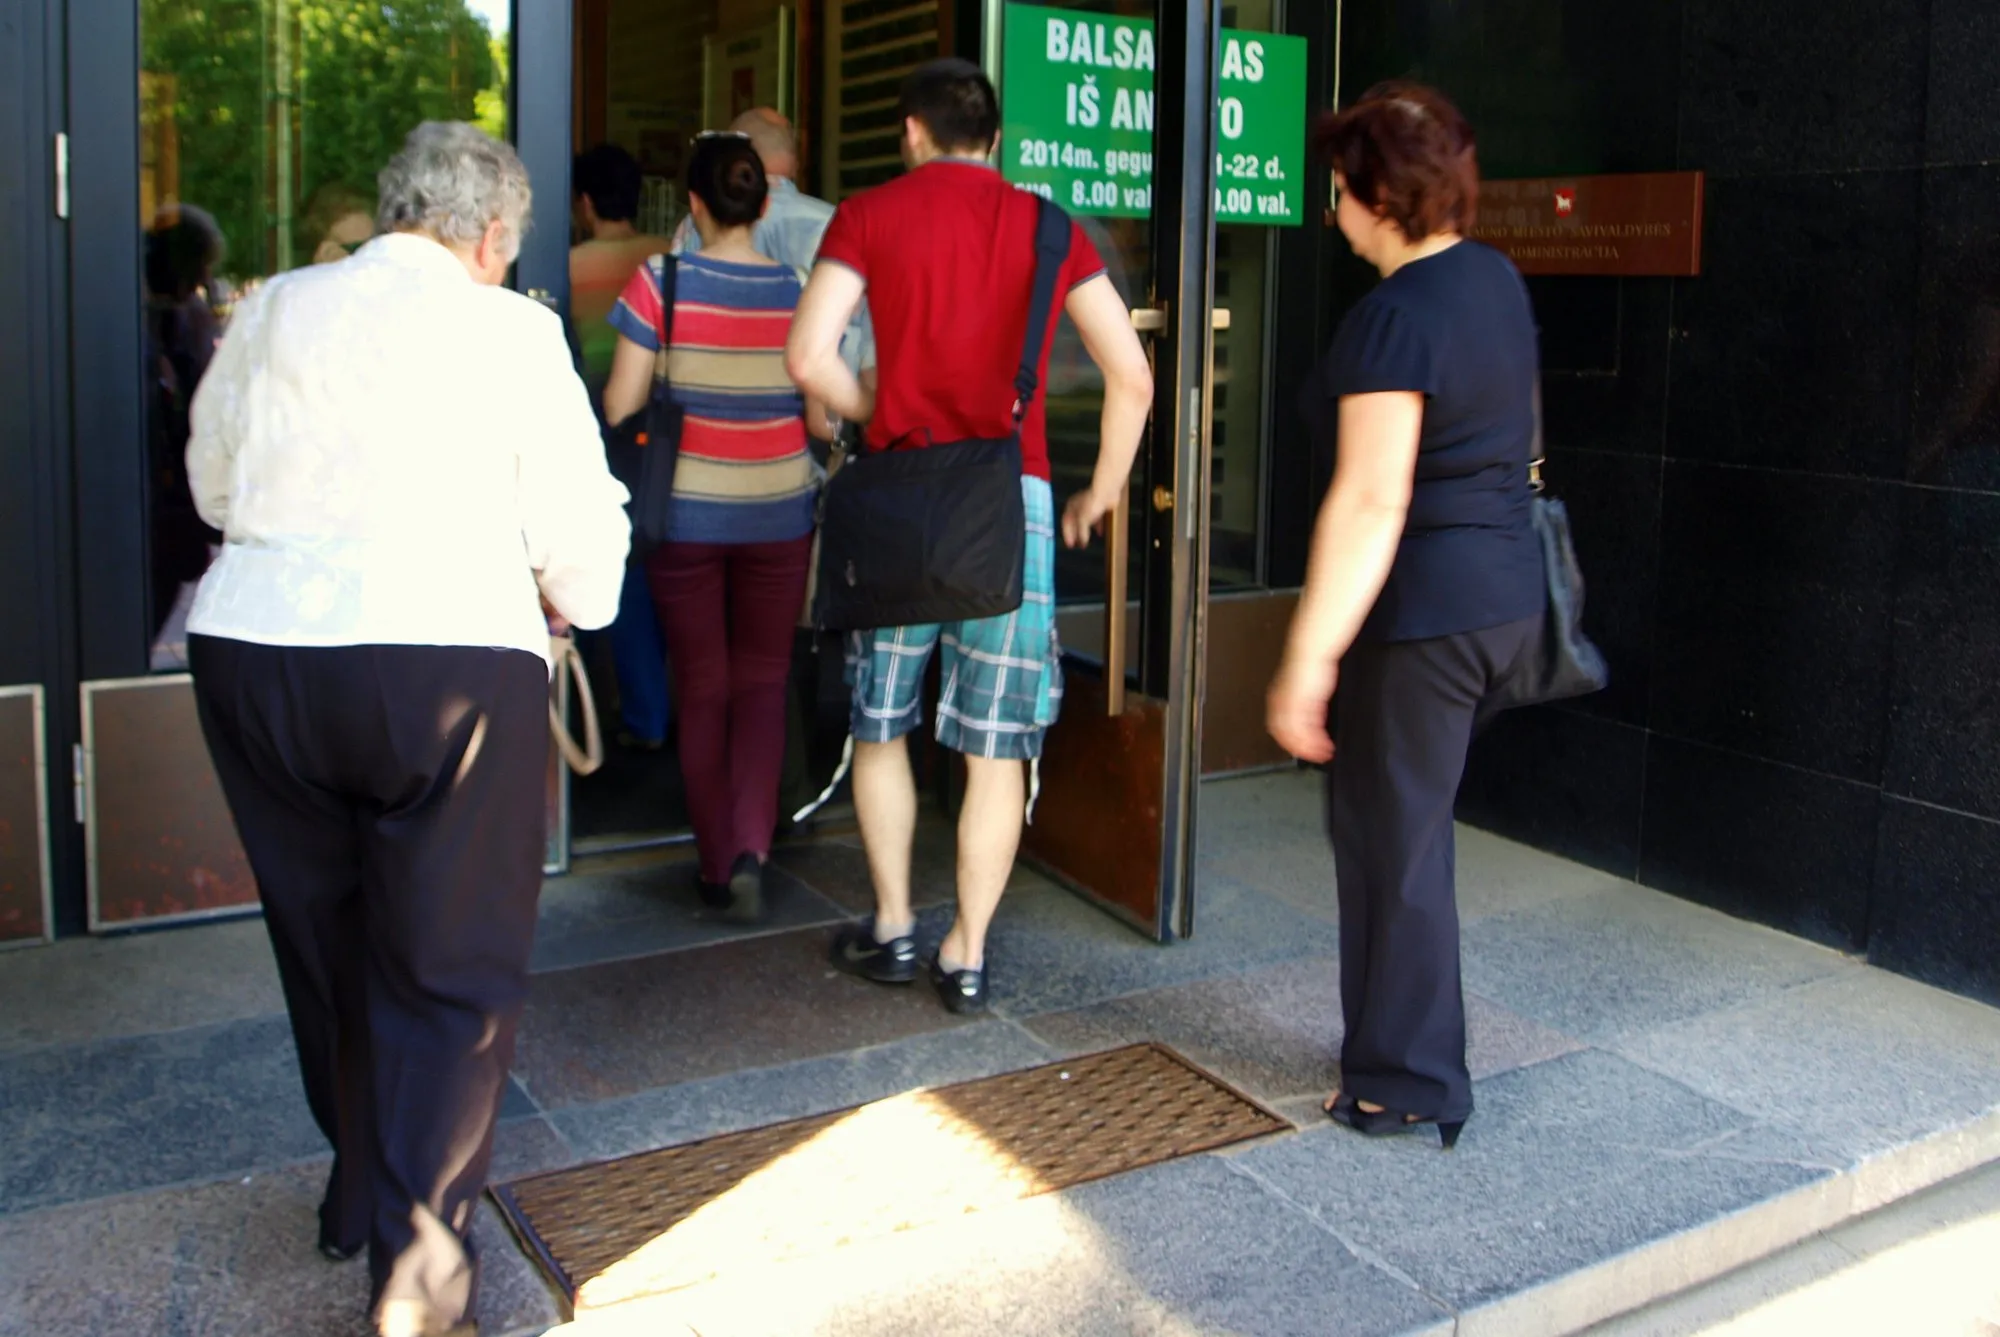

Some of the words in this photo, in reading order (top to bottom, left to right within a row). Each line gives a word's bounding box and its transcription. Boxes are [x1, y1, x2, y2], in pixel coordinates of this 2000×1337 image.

[1066, 73, 1100, 127] IŠ
[1019, 138, 1099, 169] 2014m.
[1105, 150, 1153, 178] gegu
[1216, 152, 1259, 178] 1-22
[1264, 156, 1285, 180] d.
[1071, 179, 1118, 208] 8.00
[1123, 184, 1152, 209] val
[1257, 191, 1291, 216] val.
